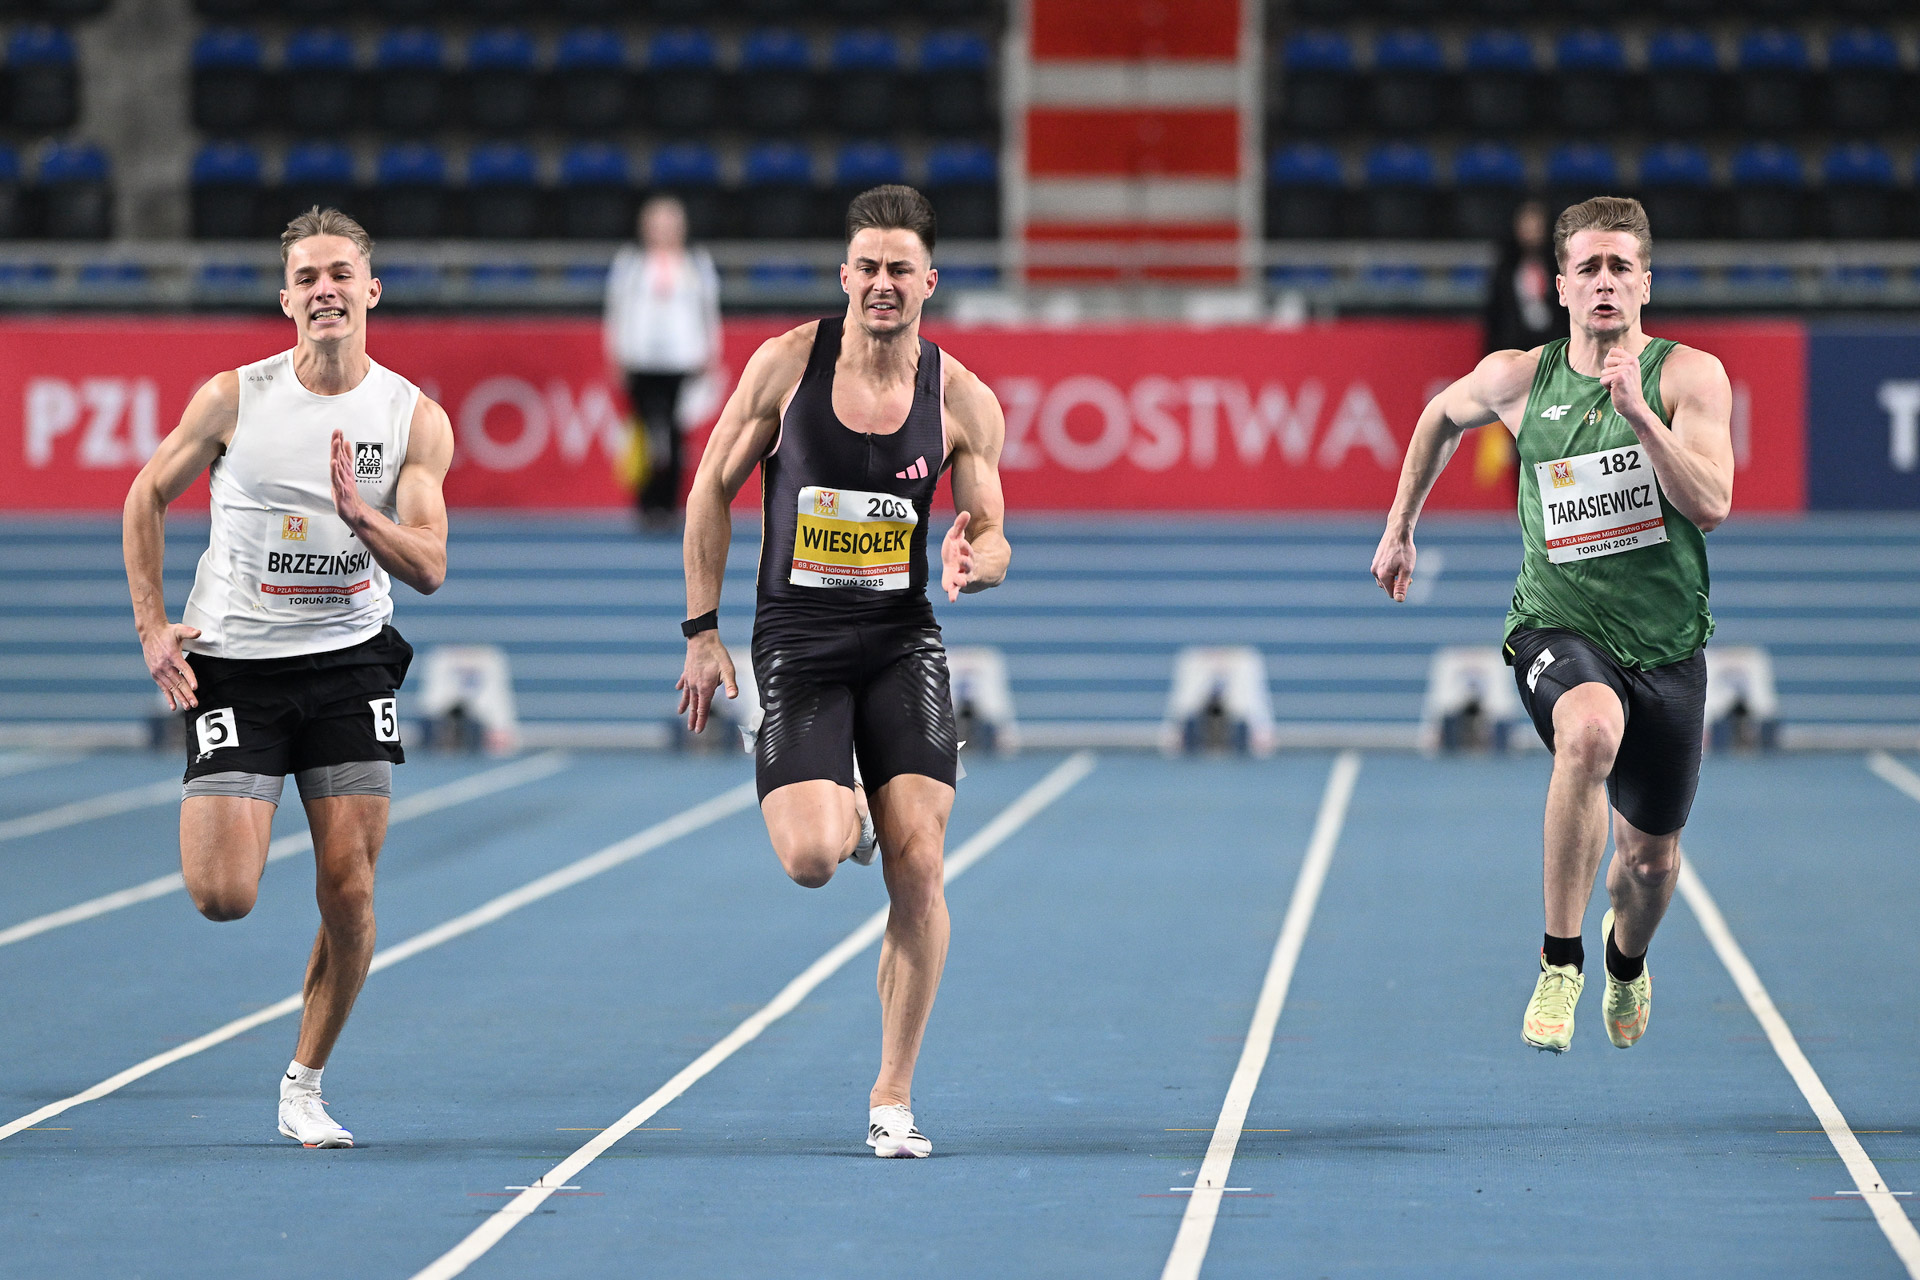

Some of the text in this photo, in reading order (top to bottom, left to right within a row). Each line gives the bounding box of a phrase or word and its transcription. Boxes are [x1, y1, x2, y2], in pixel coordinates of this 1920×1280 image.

[24, 374, 185, 468] PZL
[985, 376, 1400, 471] ZOSTWA
[1541, 405, 1572, 421] 4F
[357, 467, 381, 475] AWF
[358, 458, 381, 467] AZS
[1600, 451, 1641, 476] 182
[1554, 478, 1576, 488] PZLA
[867, 497, 908, 519] 200
[1549, 484, 1653, 526] TARASIEWICZ
[283, 532, 306, 541] PZLA
[802, 525, 908, 554] WIESIOŁEK
[1551, 520, 1660, 548] 69. PZLA Halowe Mistrzostwa Polski
[1576, 536, 1639, 556] TORUŃ 2025
[267, 550, 370, 576] BRZEZIŃSKI
[798, 561, 906, 575] 69. PZLA Halowe Mistrzostwa Polski
[265, 585, 276, 593] 69.
[354, 583, 368, 591] Polski
[821, 576, 884, 587] TORUŃ 2025
[289, 595, 351, 605] TORUŃ 2025
[205, 712, 228, 745] 5
[381, 701, 394, 738] 5
